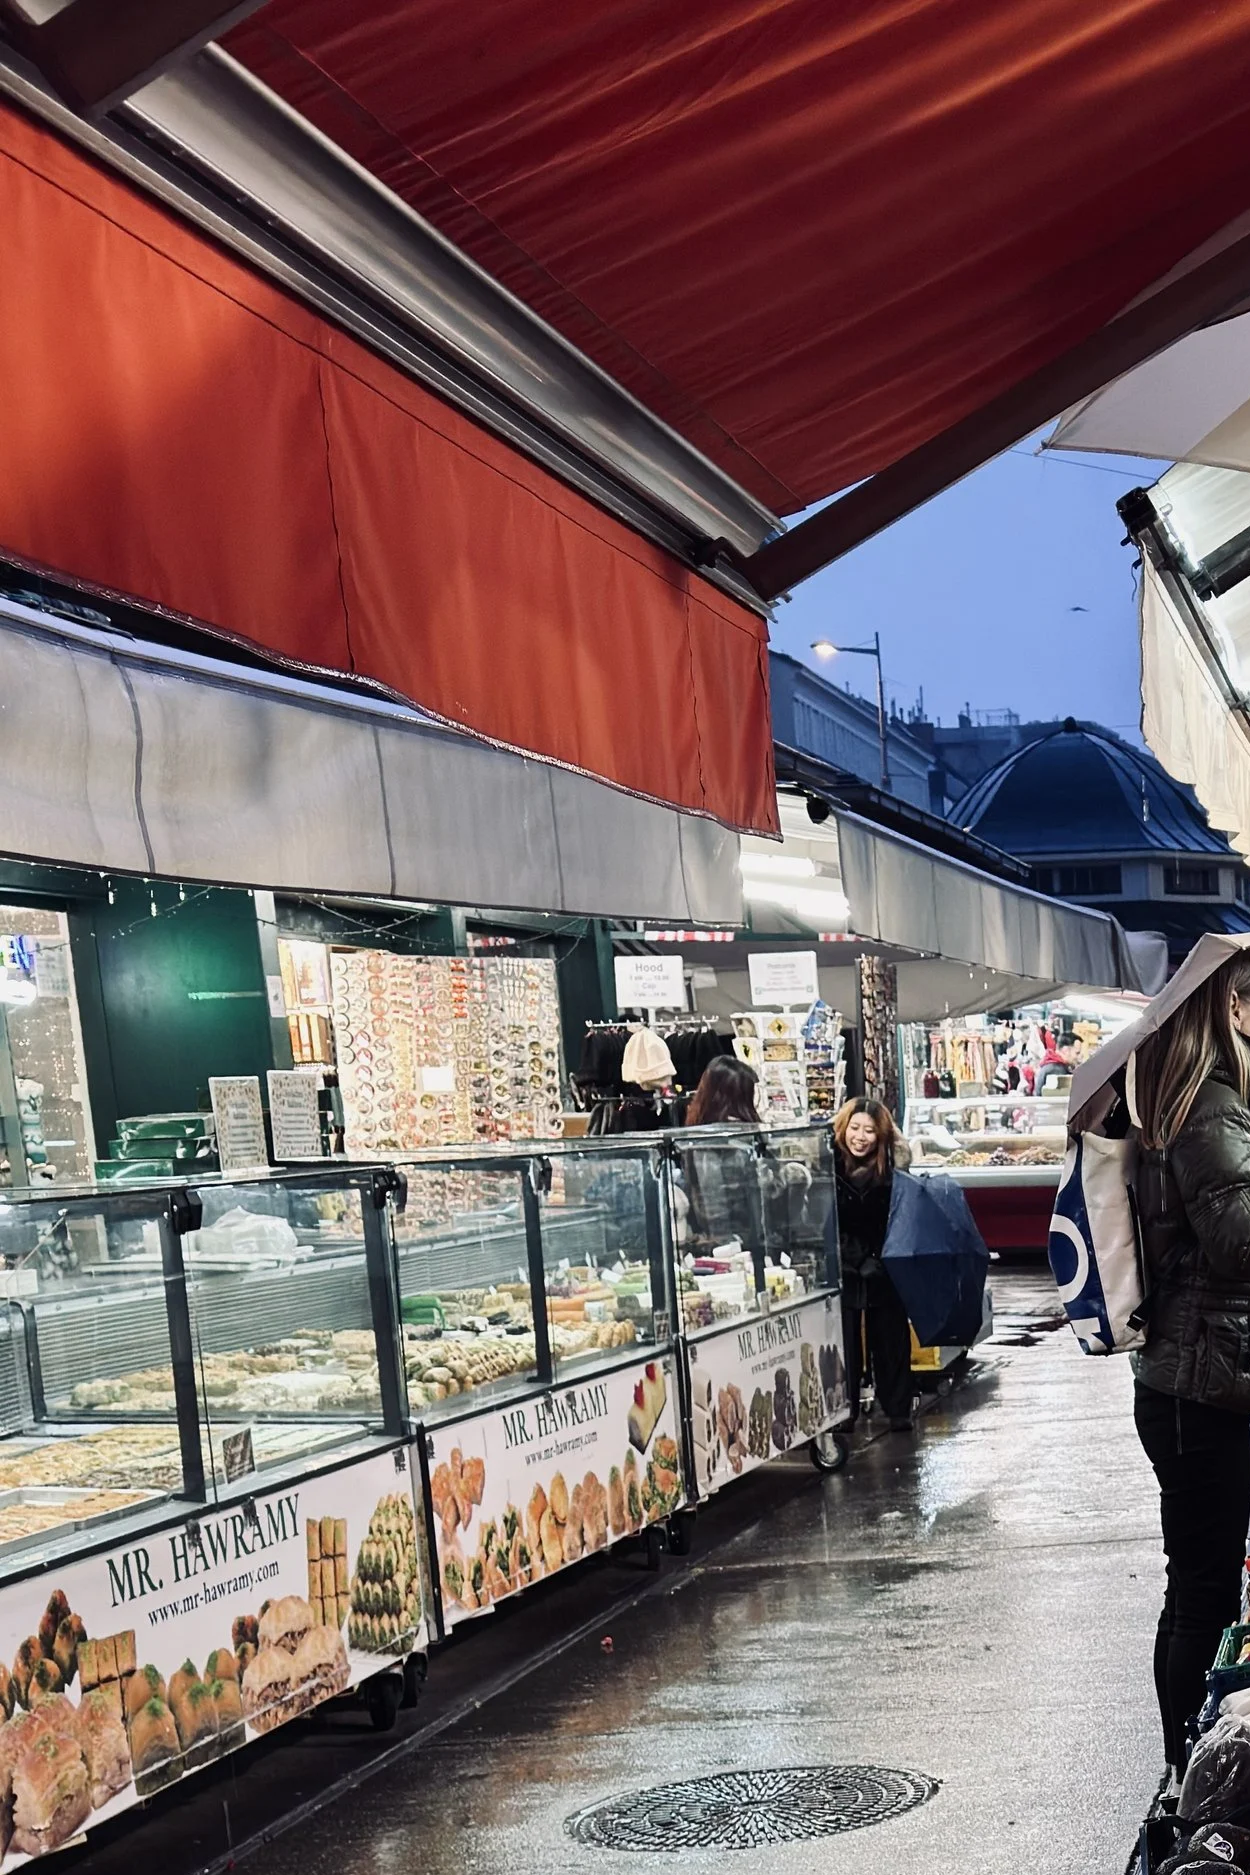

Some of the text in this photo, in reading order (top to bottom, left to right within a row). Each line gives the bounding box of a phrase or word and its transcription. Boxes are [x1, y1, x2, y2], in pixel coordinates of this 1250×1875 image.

[635, 963, 664, 973] Hood
[502, 1383, 609, 1450] MR. HAWRAMY
[525, 1431, 598, 1467] www.mr-hawramy.com
[106, 1493, 300, 1608] MR. HAWRAMY
[148, 1560, 280, 1627] www.mr-hawramy.com
